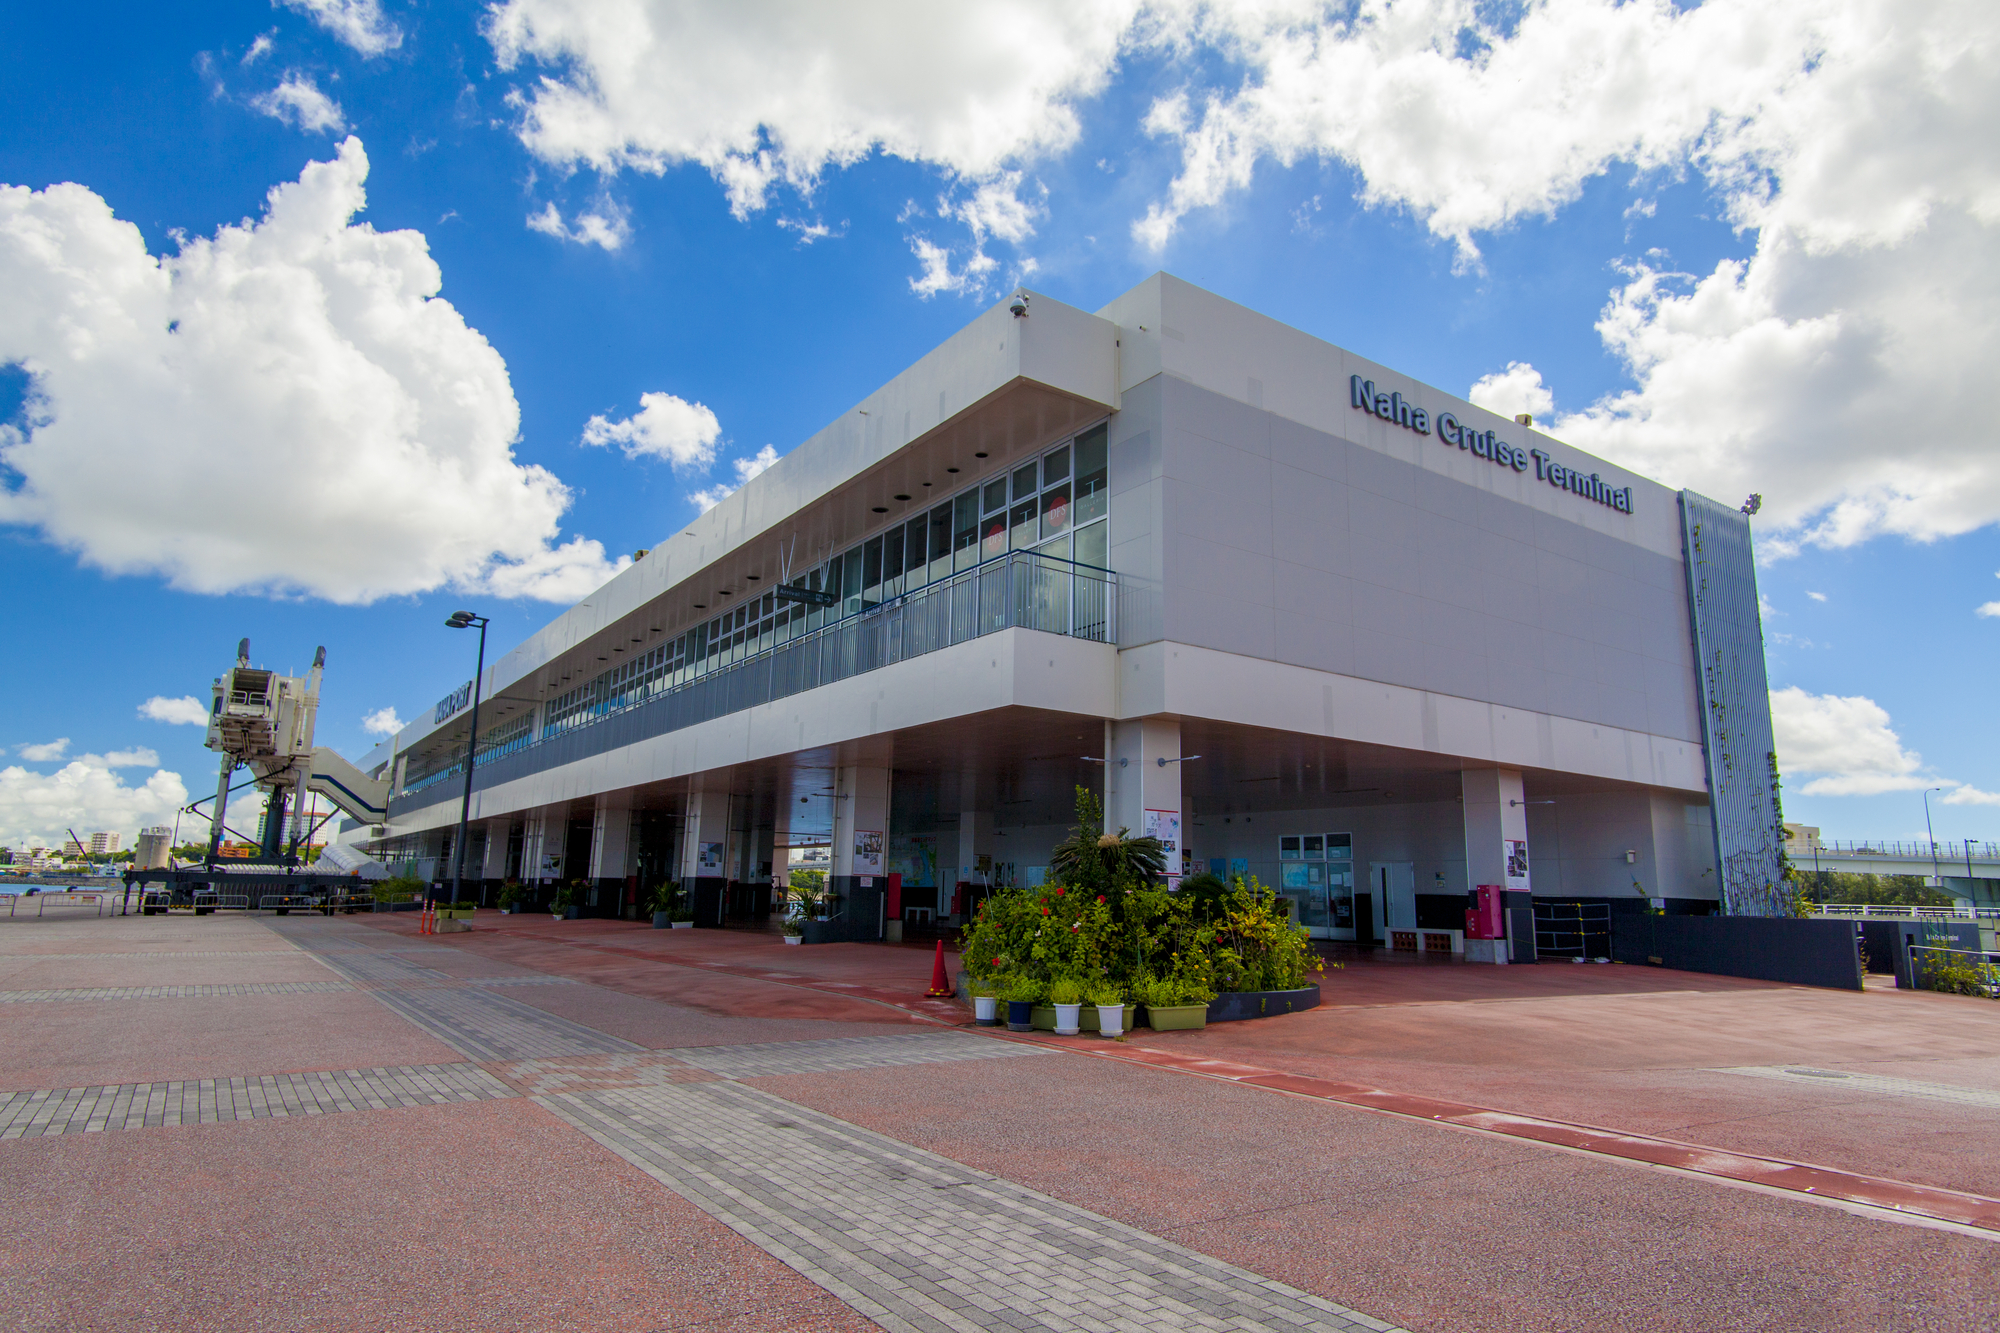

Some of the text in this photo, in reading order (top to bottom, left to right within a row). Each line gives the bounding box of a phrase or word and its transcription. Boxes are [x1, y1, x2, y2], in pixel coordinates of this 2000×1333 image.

[1350, 374, 1634, 515] Naha Cruise Terminal
[1050, 504, 1066, 520] DFS
[988, 533, 1003, 546] DFS
[779, 588, 801, 598] Arrival
[452, 680, 472, 714] PORT
